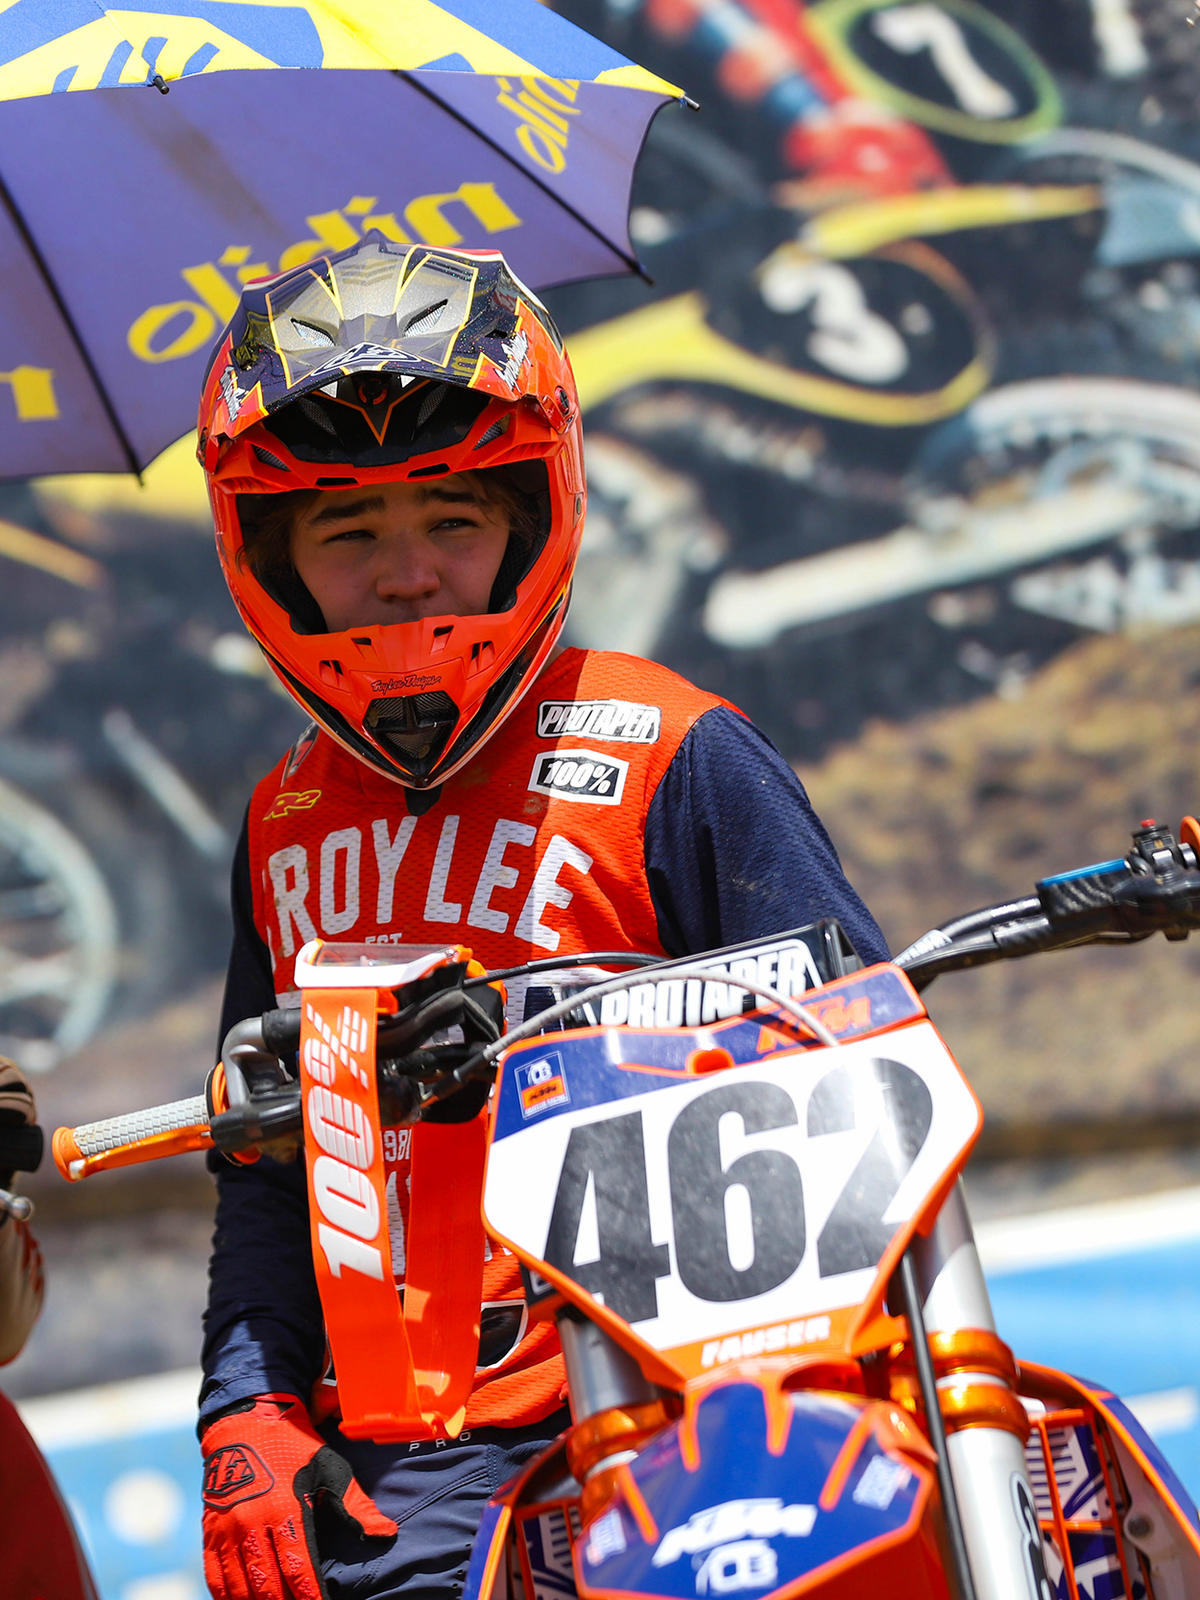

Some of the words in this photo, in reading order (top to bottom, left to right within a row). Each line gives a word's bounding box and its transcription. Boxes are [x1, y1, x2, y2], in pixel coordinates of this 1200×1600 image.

[541, 704, 656, 739] PROTAPER
[543, 760, 614, 795] 100%
[424, 815, 594, 951] LEE
[543, 1057, 933, 1325] 462
[701, 1315, 832, 1368] FAUSER
